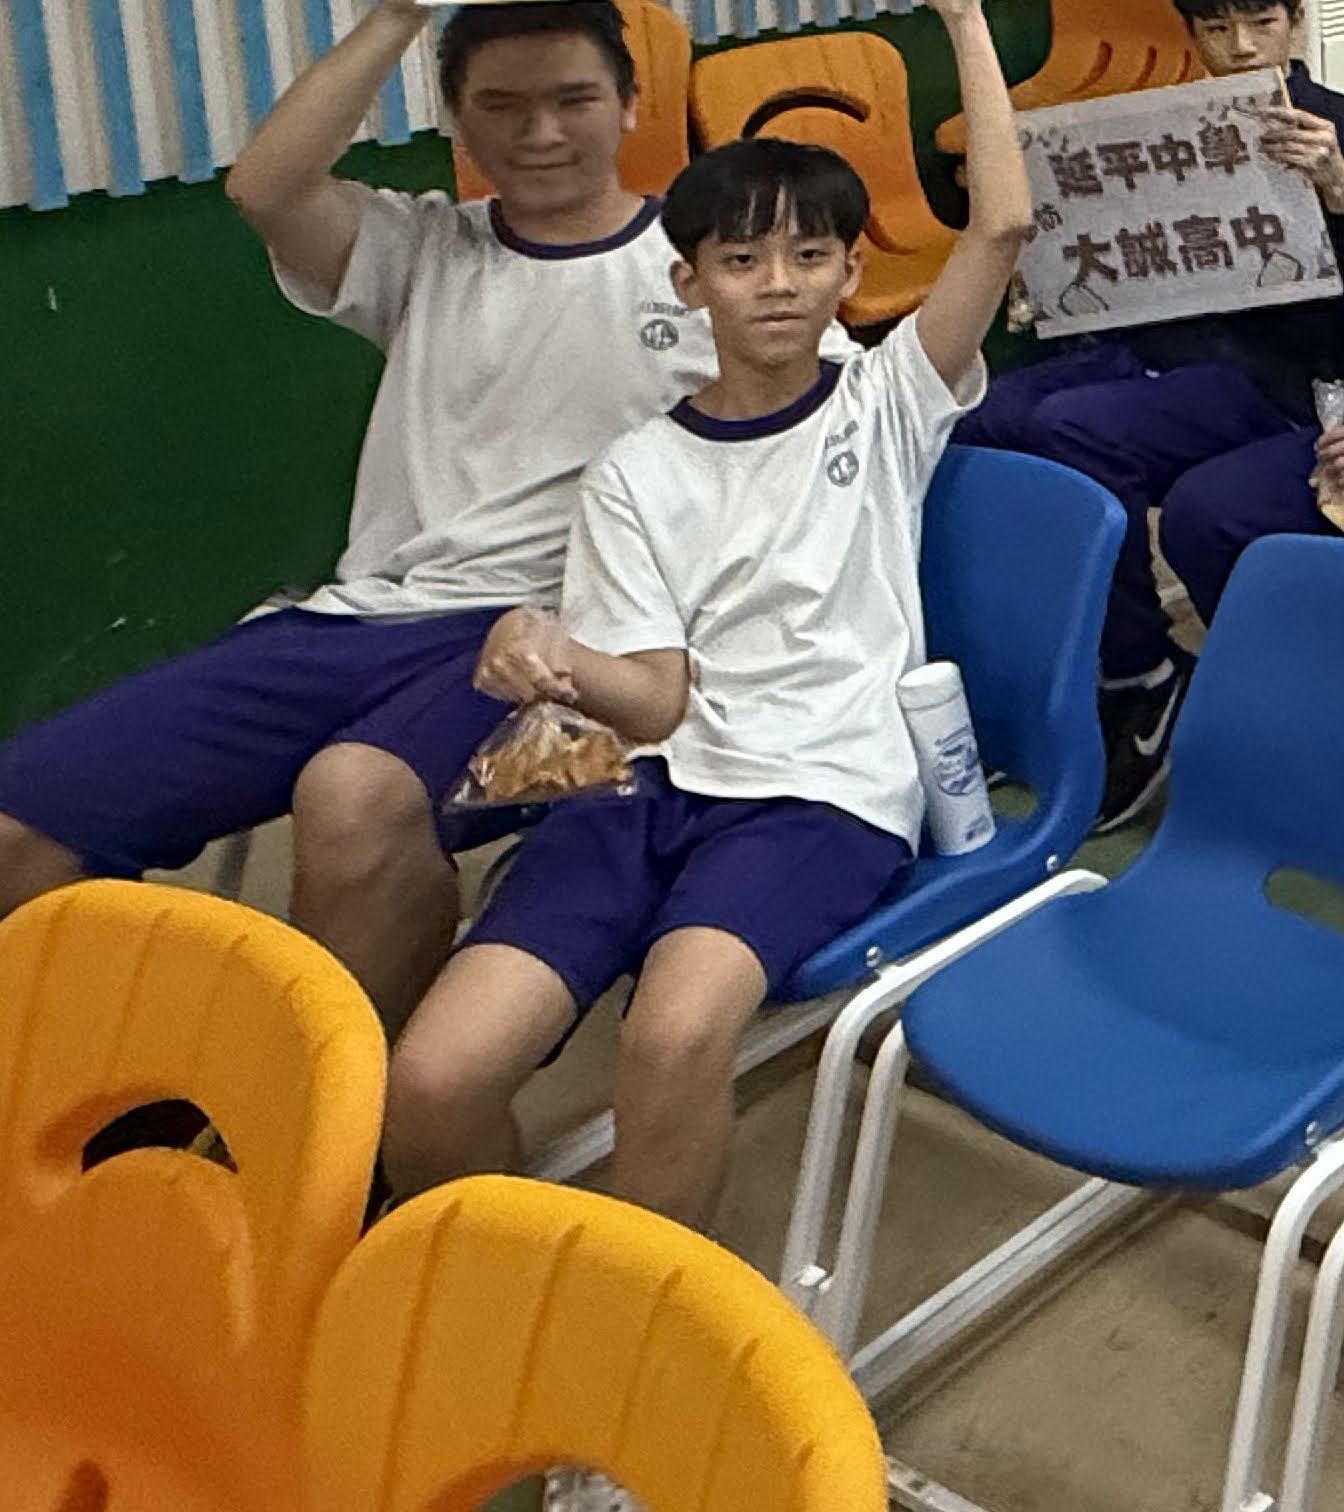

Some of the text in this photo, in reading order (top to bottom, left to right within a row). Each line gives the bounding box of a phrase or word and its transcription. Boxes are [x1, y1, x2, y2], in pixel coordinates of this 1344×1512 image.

[1048, 124, 1251, 199] 延平中學
[1062, 205, 1285, 283] 大誠高中
